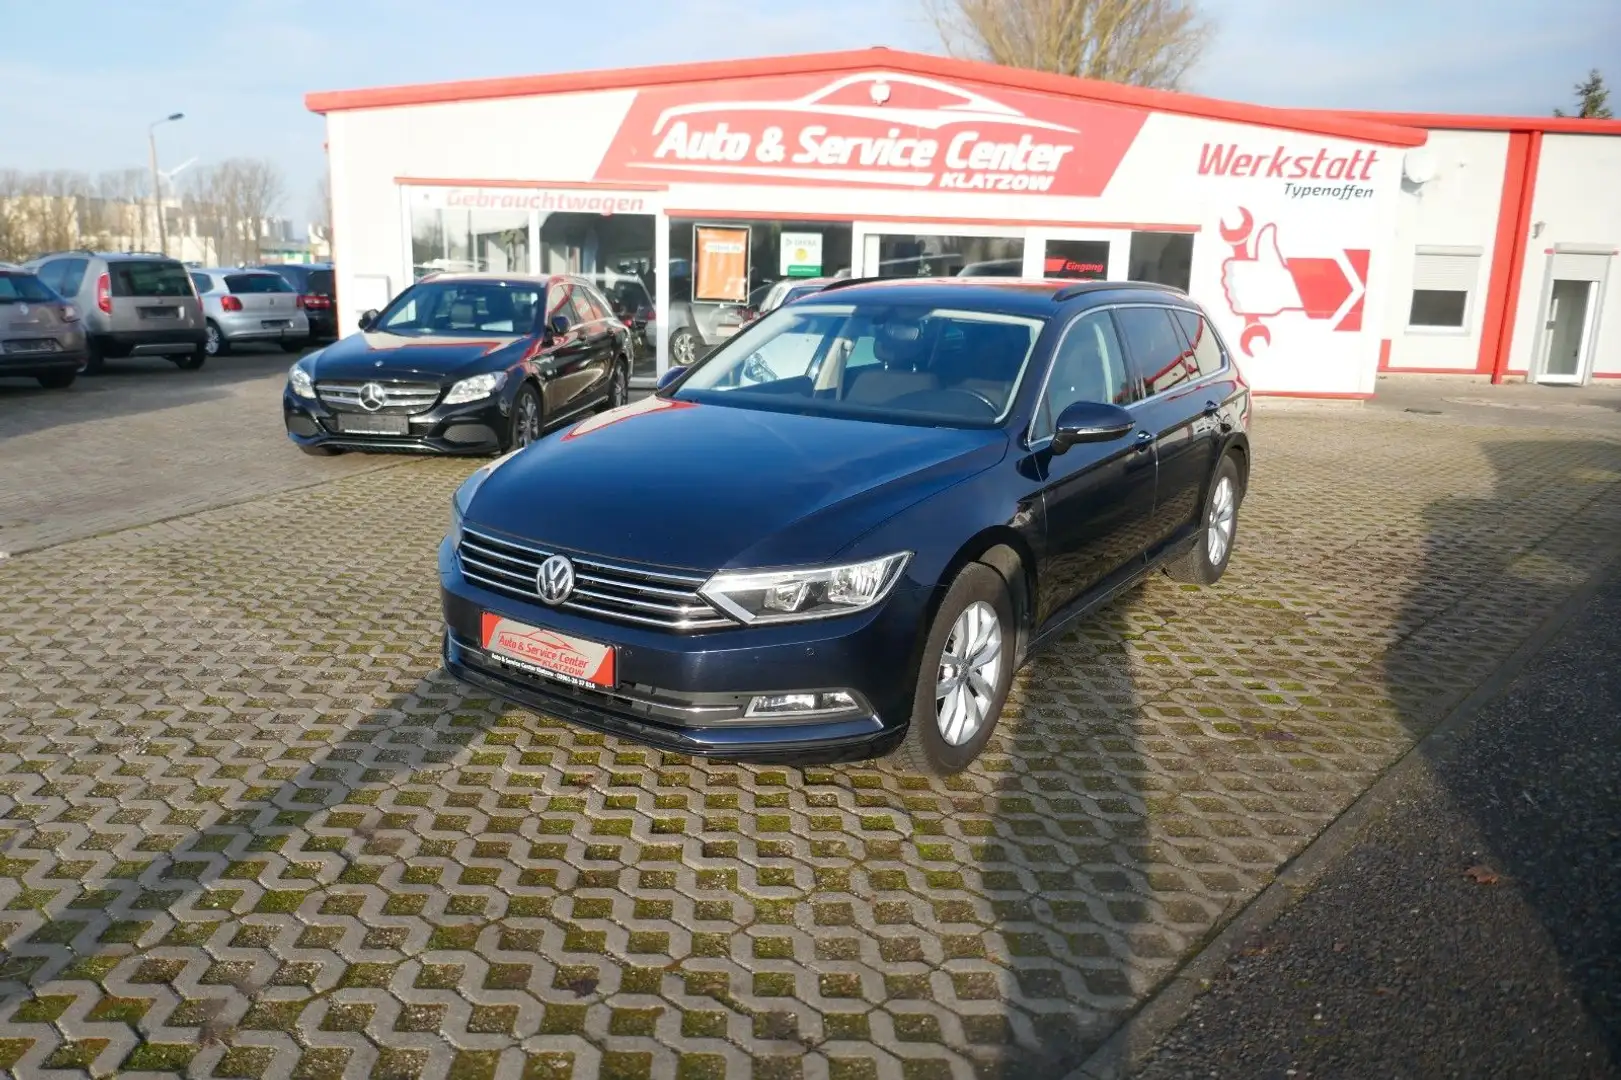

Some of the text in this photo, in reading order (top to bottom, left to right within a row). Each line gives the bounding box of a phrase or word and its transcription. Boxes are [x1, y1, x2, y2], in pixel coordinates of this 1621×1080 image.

[654, 121, 1074, 174] Auto & Service Center
[1197, 143, 1380, 181] Werkstatt
[939, 172, 1055, 192] KLATZOW
[1284, 182, 1374, 200] Typenoffen
[446, 188, 645, 217] Gebrauchtwagen
[1066, 261, 1104, 273] Eingang
[499, 635, 590, 668] Auto & Service Center
[542, 660, 585, 677] KLATZOW
